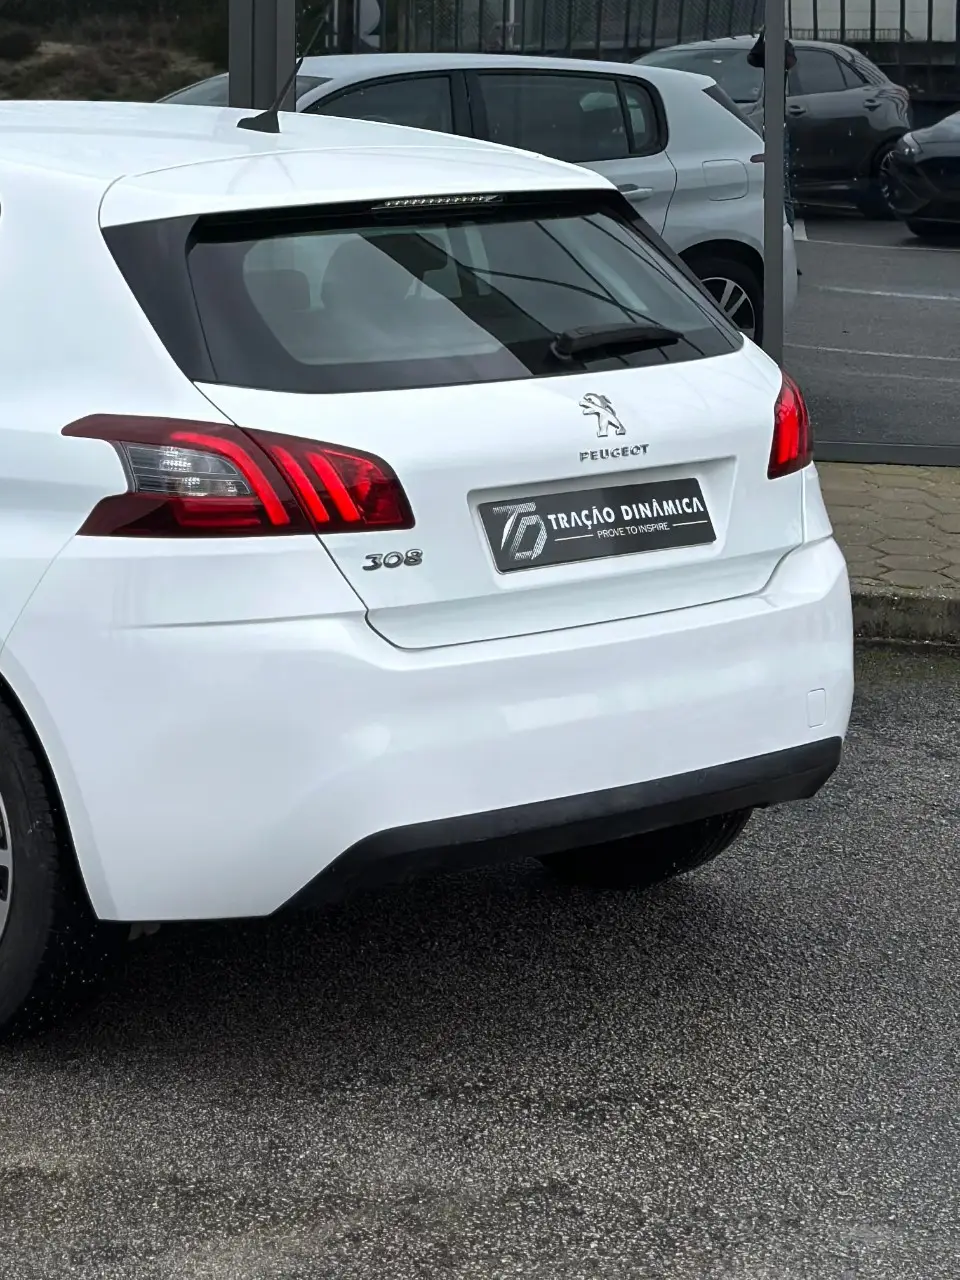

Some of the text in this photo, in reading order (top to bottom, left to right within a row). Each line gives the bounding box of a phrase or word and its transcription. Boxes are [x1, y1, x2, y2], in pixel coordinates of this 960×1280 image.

[579, 443, 650, 462] PEUGEOT
[547, 495, 705, 530] TRAÇÃO DINÂMICA
[596, 521, 670, 540] PROVE TO INSPIRE
[362, 548, 424, 571] 308
